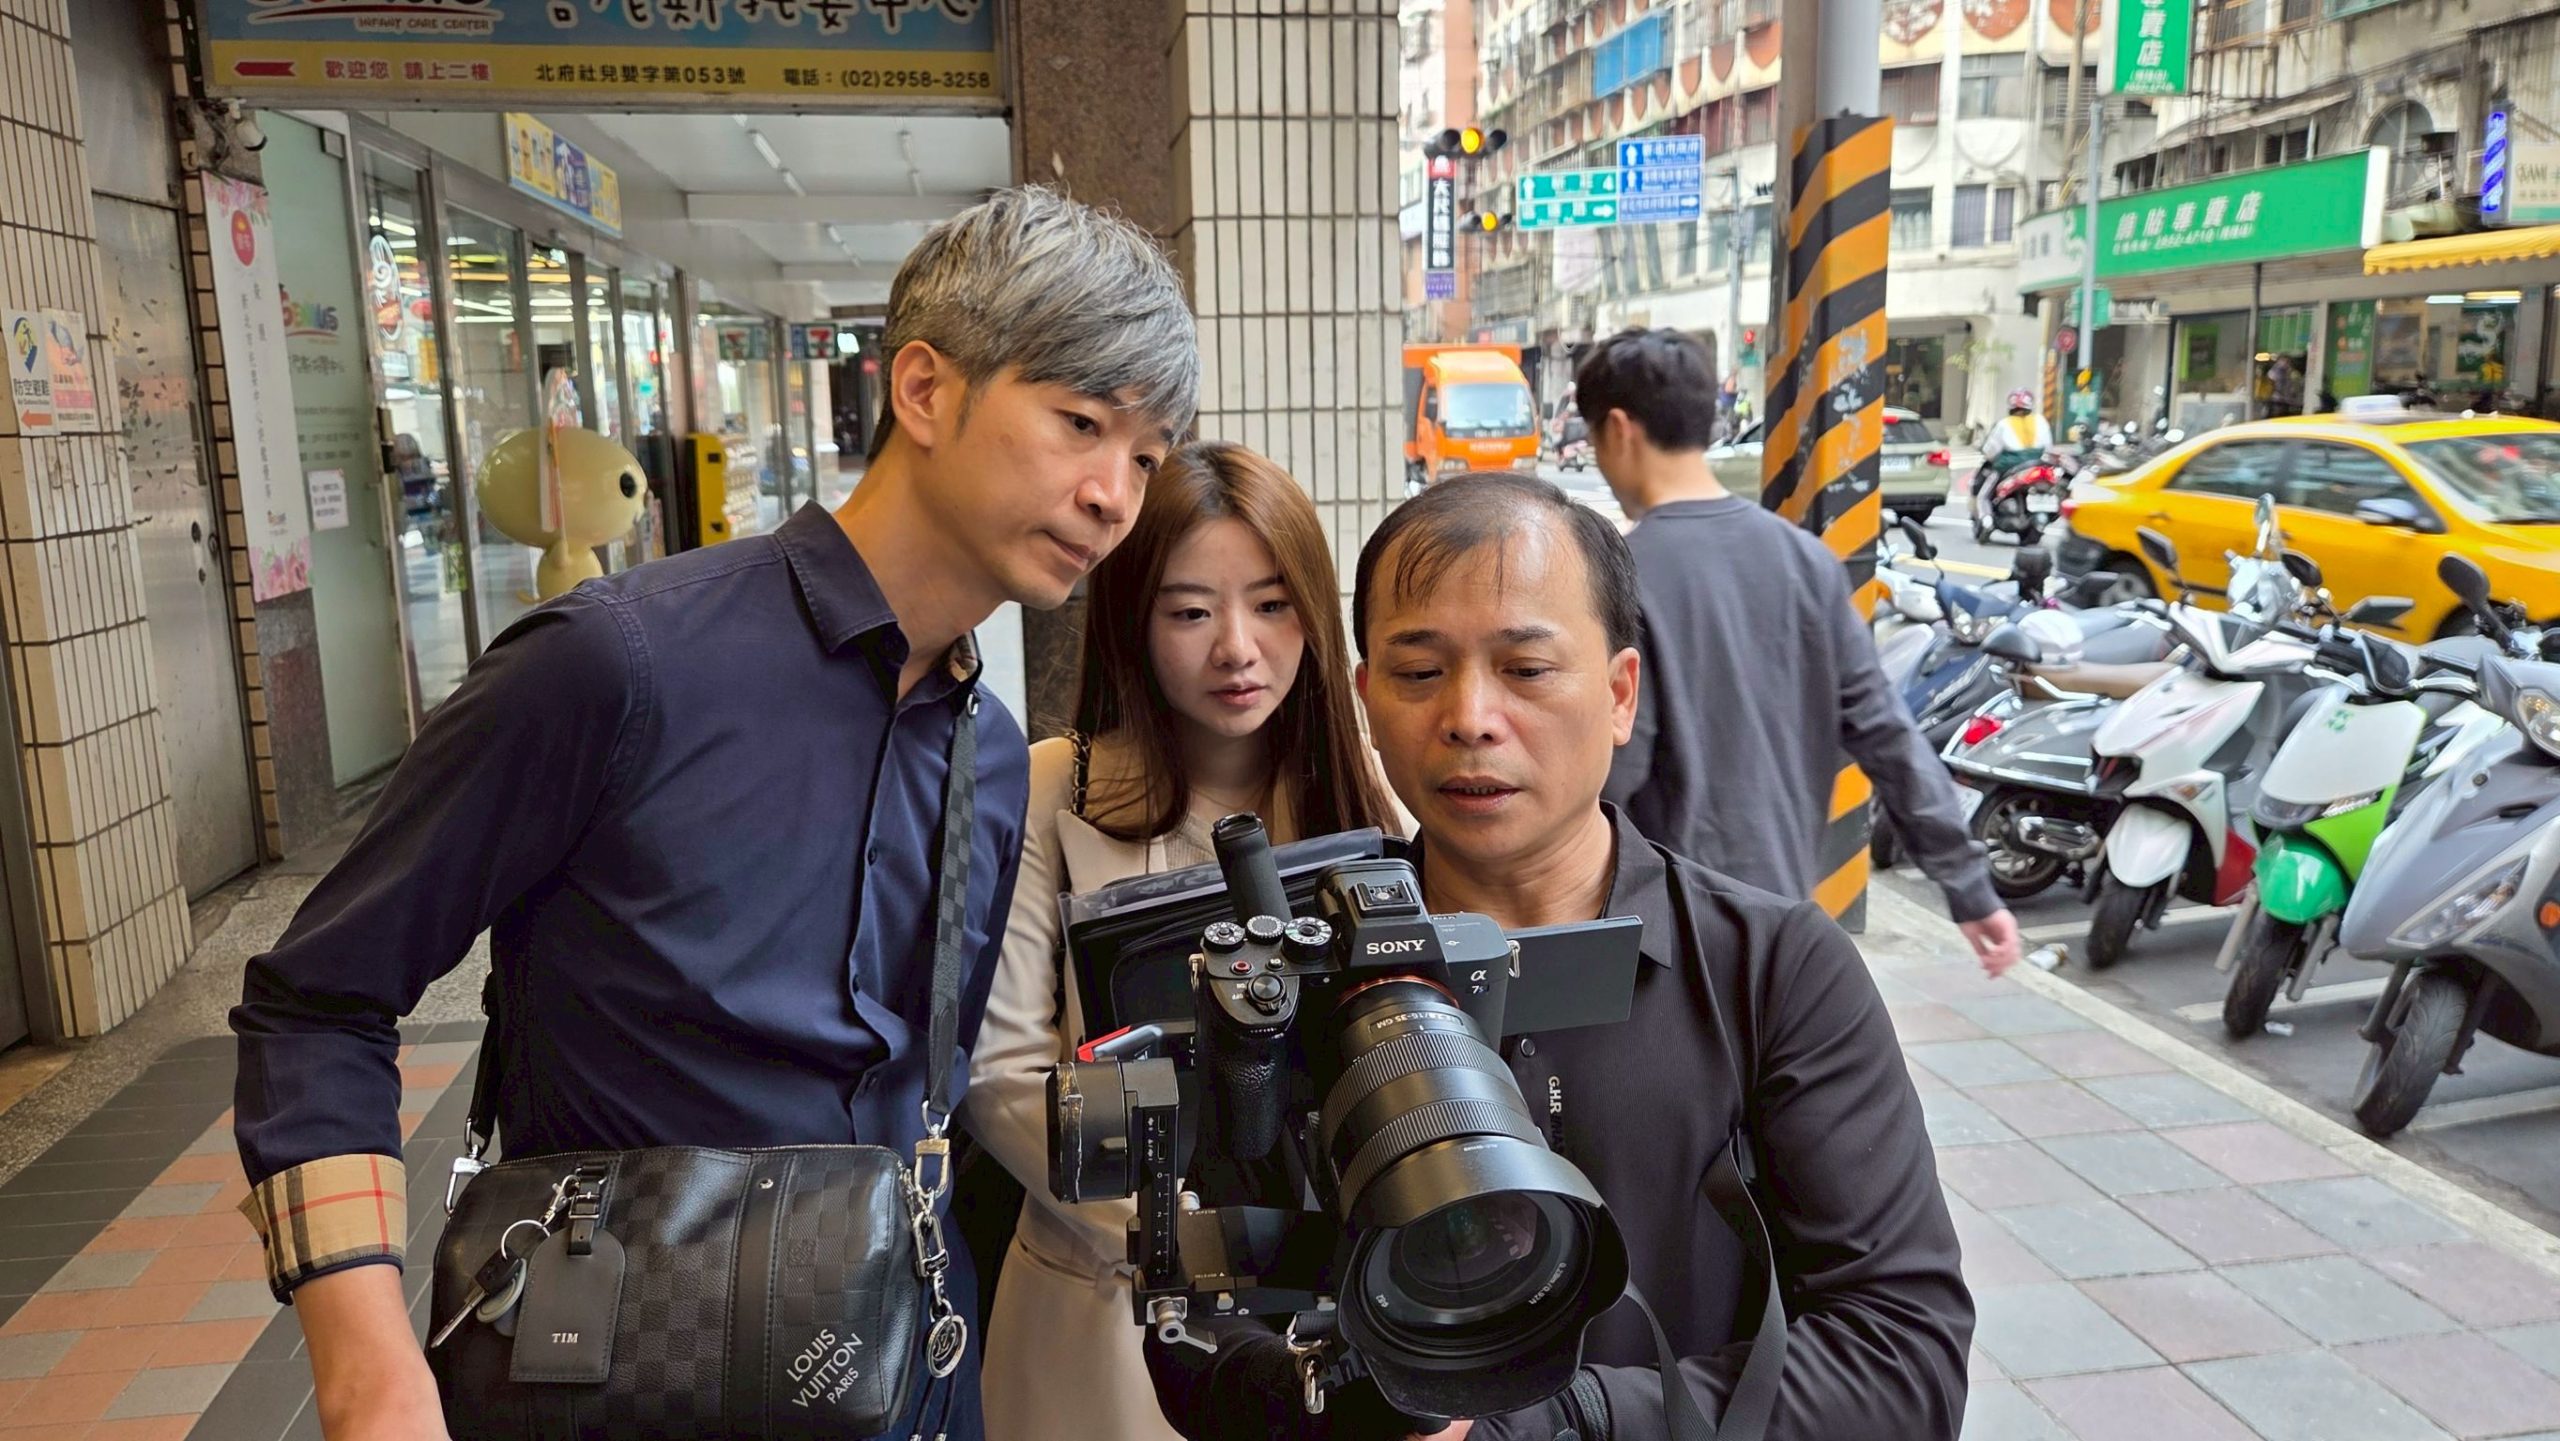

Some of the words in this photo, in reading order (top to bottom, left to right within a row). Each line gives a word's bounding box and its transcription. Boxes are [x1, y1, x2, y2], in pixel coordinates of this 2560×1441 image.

[407, 19, 438, 29] CARE
[443, 19, 490, 30] CENTER
[324, 61, 390, 80] 歡迎您
[404, 62, 490, 81] 請上二樓
[1366, 939, 1426, 955] SONY
[1376, 1018, 1394, 1029] GM
[552, 1333, 579, 1344] TIM
[786, 1328, 836, 1382] LOUIS
[791, 1332, 863, 1407] VUITTON
[826, 1367, 859, 1404] PARIS
